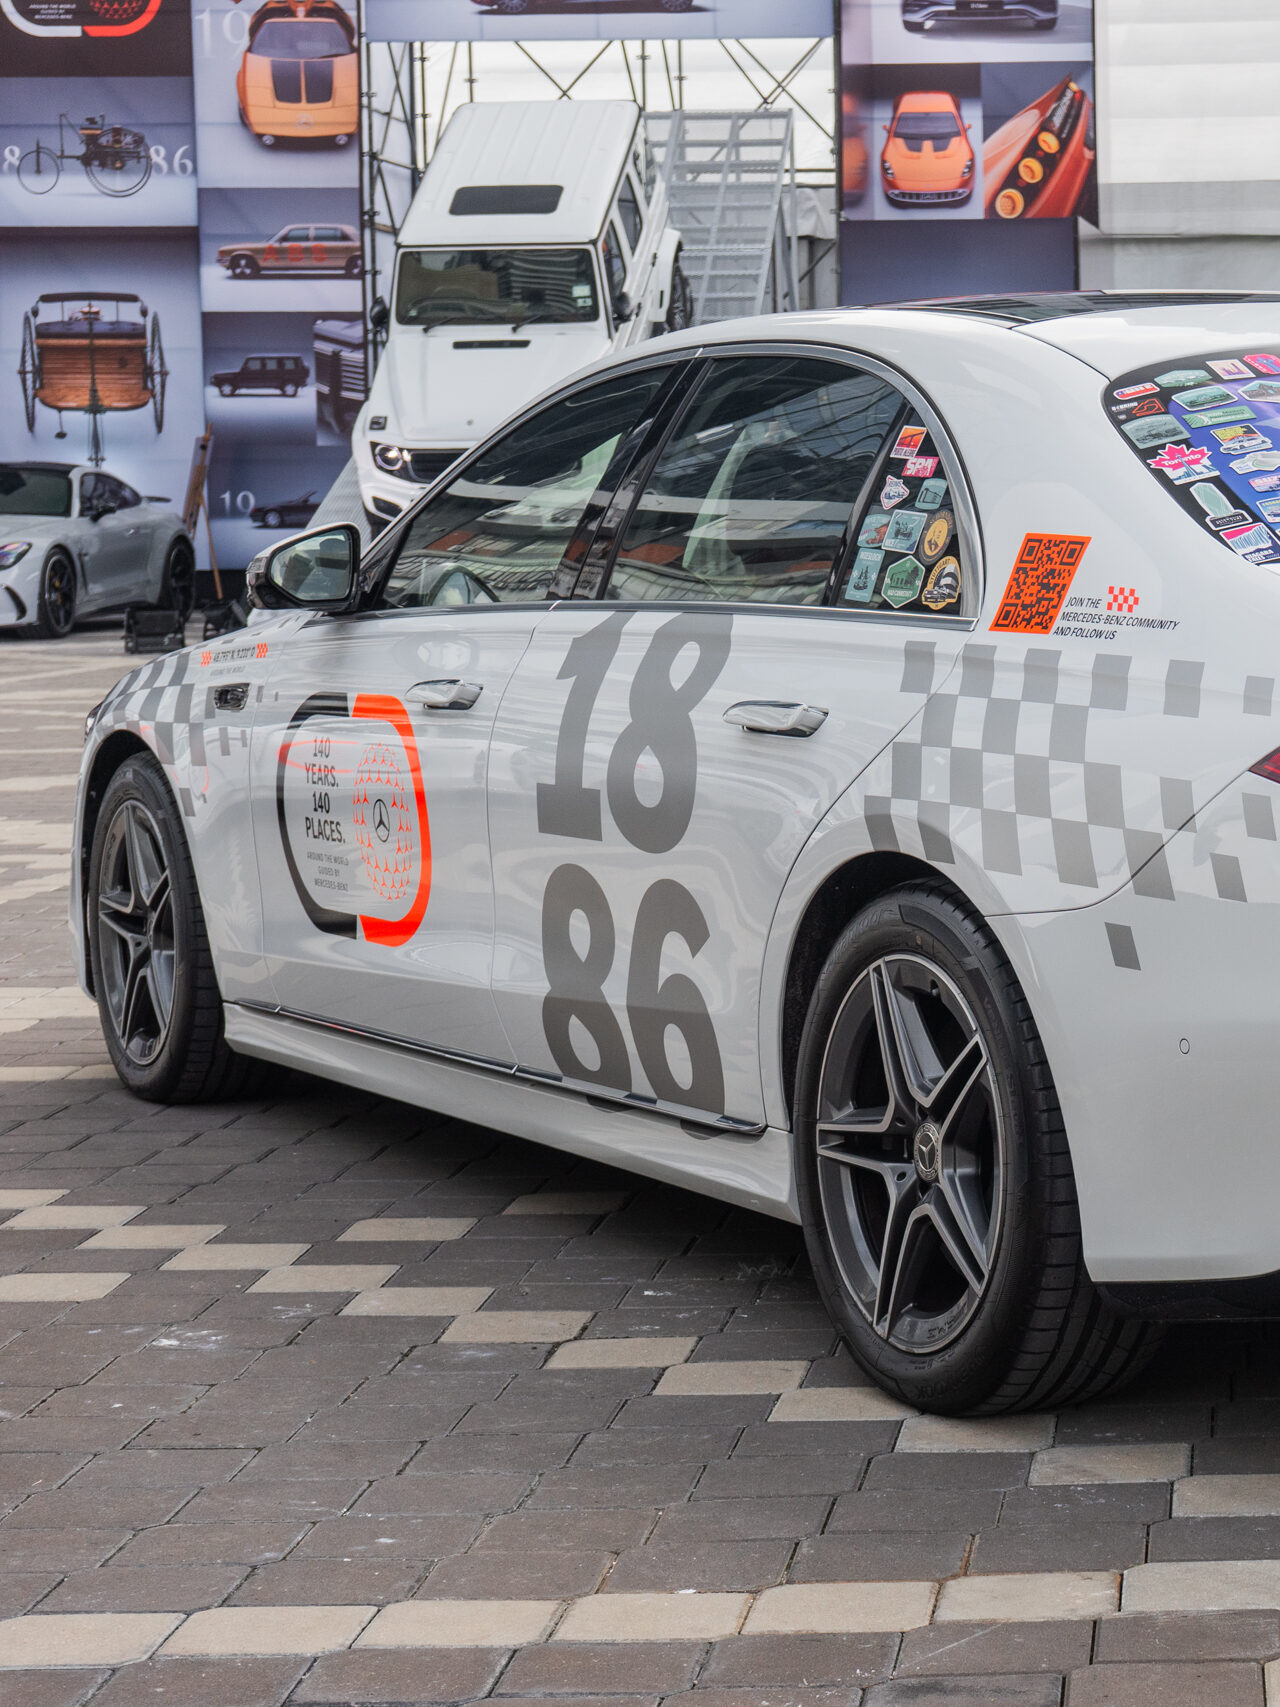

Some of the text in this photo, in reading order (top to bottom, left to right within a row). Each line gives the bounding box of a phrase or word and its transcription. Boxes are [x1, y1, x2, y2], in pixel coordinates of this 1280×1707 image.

[150, 145, 193, 176] 86
[1066, 597, 1102, 609] JOIN THE
[1053, 626, 1118, 640] AND FOLLOW US
[1060, 611, 1180, 631] MERCEDES-BENZ COMMUNITY
[536, 609, 733, 854] 18
[313, 736, 331, 758] 140
[305, 762, 339, 788] YEARS.
[312, 791, 331, 814] 140
[305, 816, 346, 844] PLACES.
[542, 863, 725, 1119] 86
